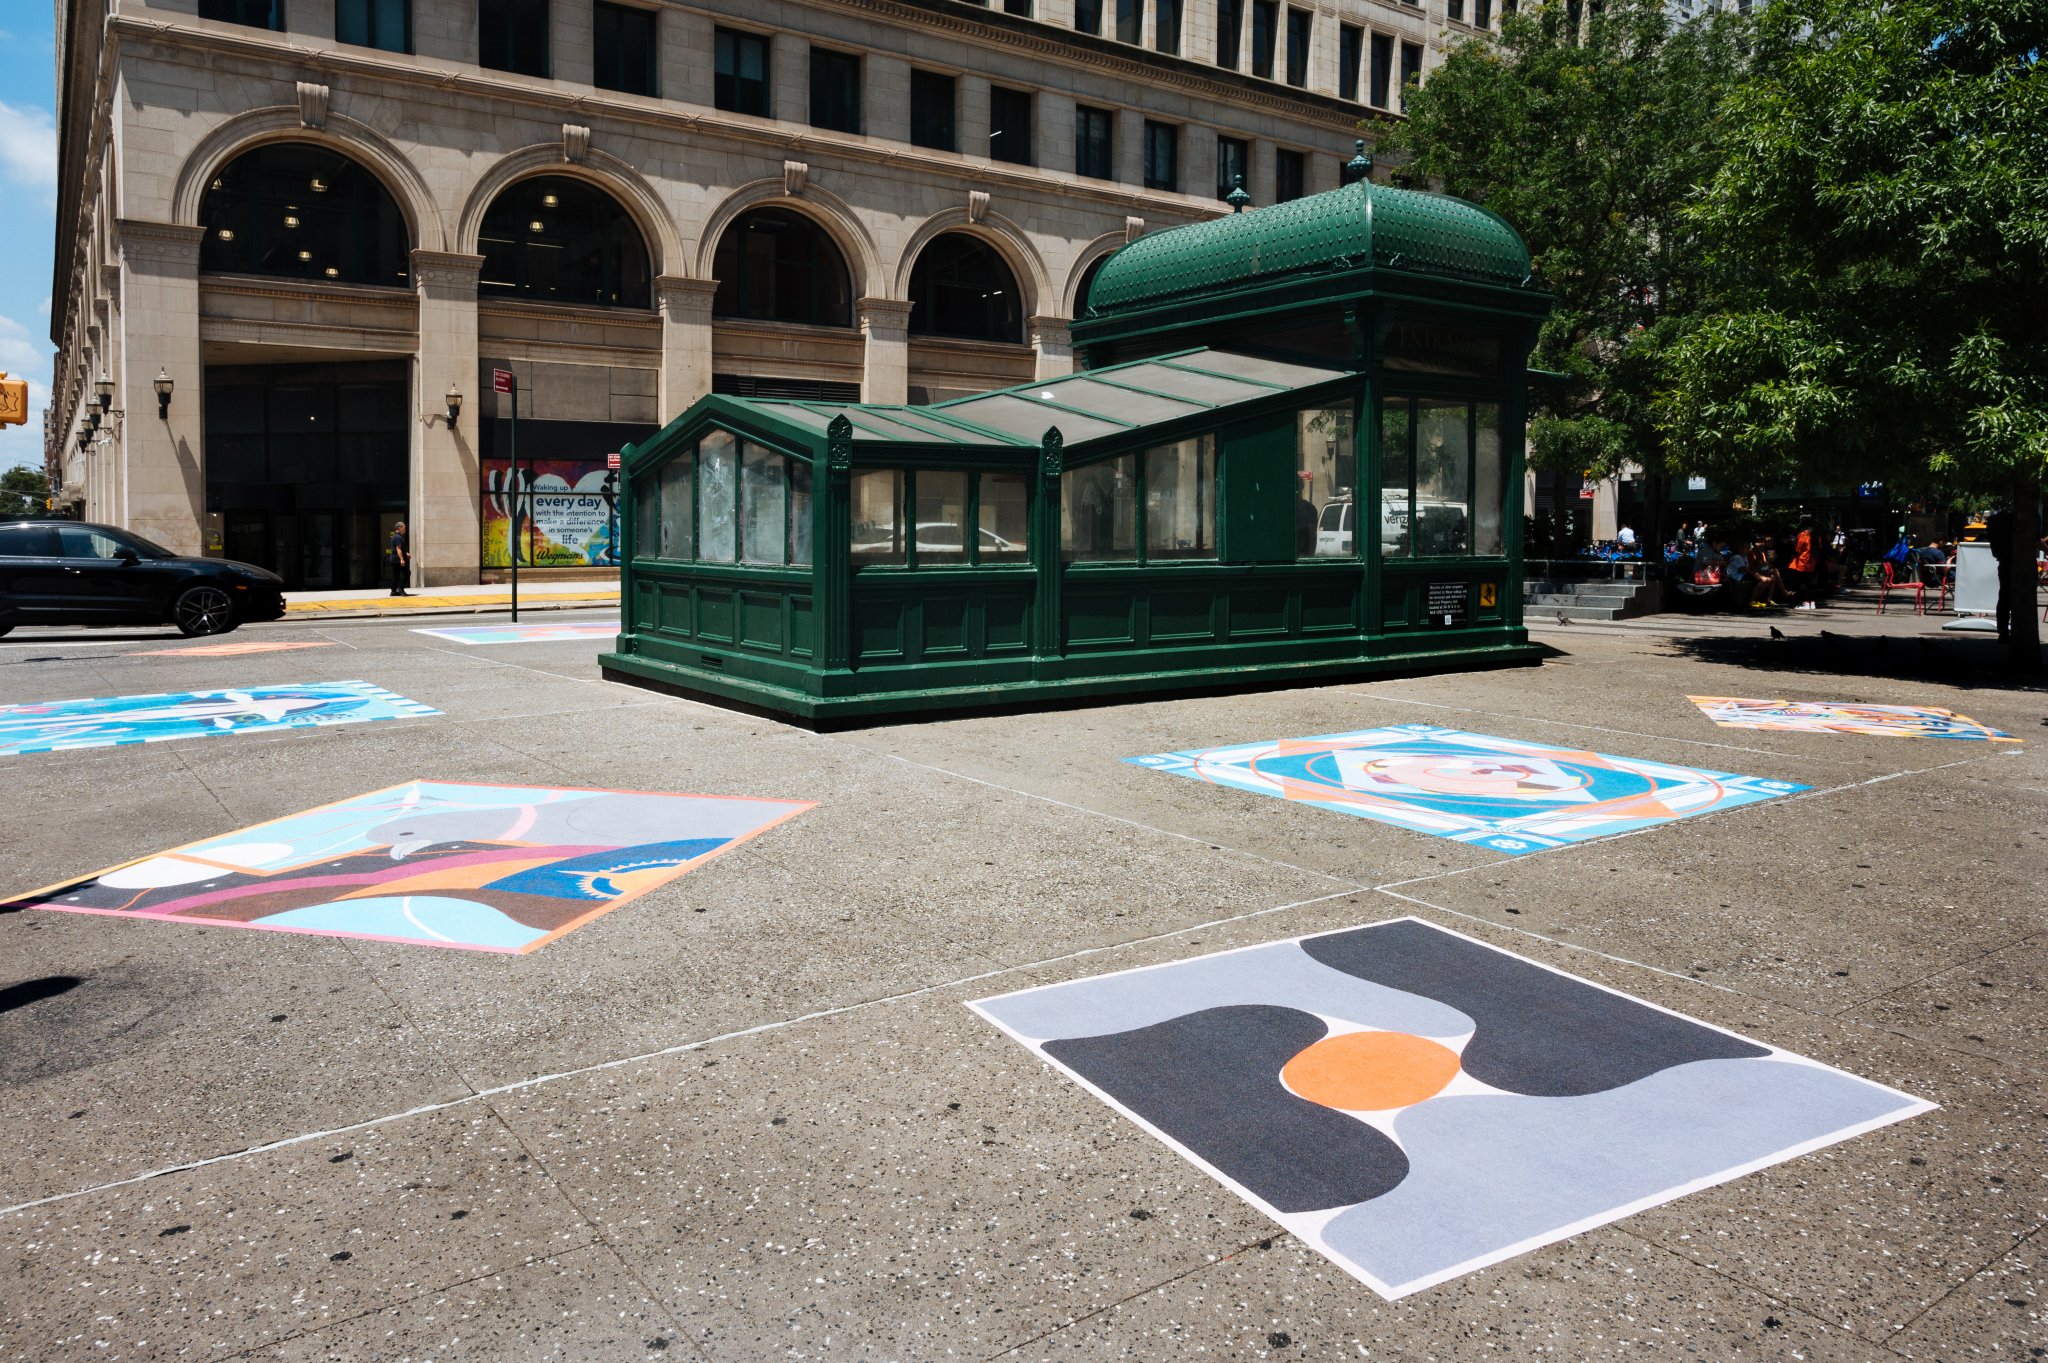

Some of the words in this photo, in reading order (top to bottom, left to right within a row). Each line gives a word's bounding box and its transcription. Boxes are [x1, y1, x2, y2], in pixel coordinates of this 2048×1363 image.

[533, 484, 558, 492] Waking
[536, 498, 575, 510] every
[578, 494, 602, 510] day
[1384, 516, 1410, 524] veriz
[562, 534, 578, 544] life
[536, 548, 584, 564] Wegmans
